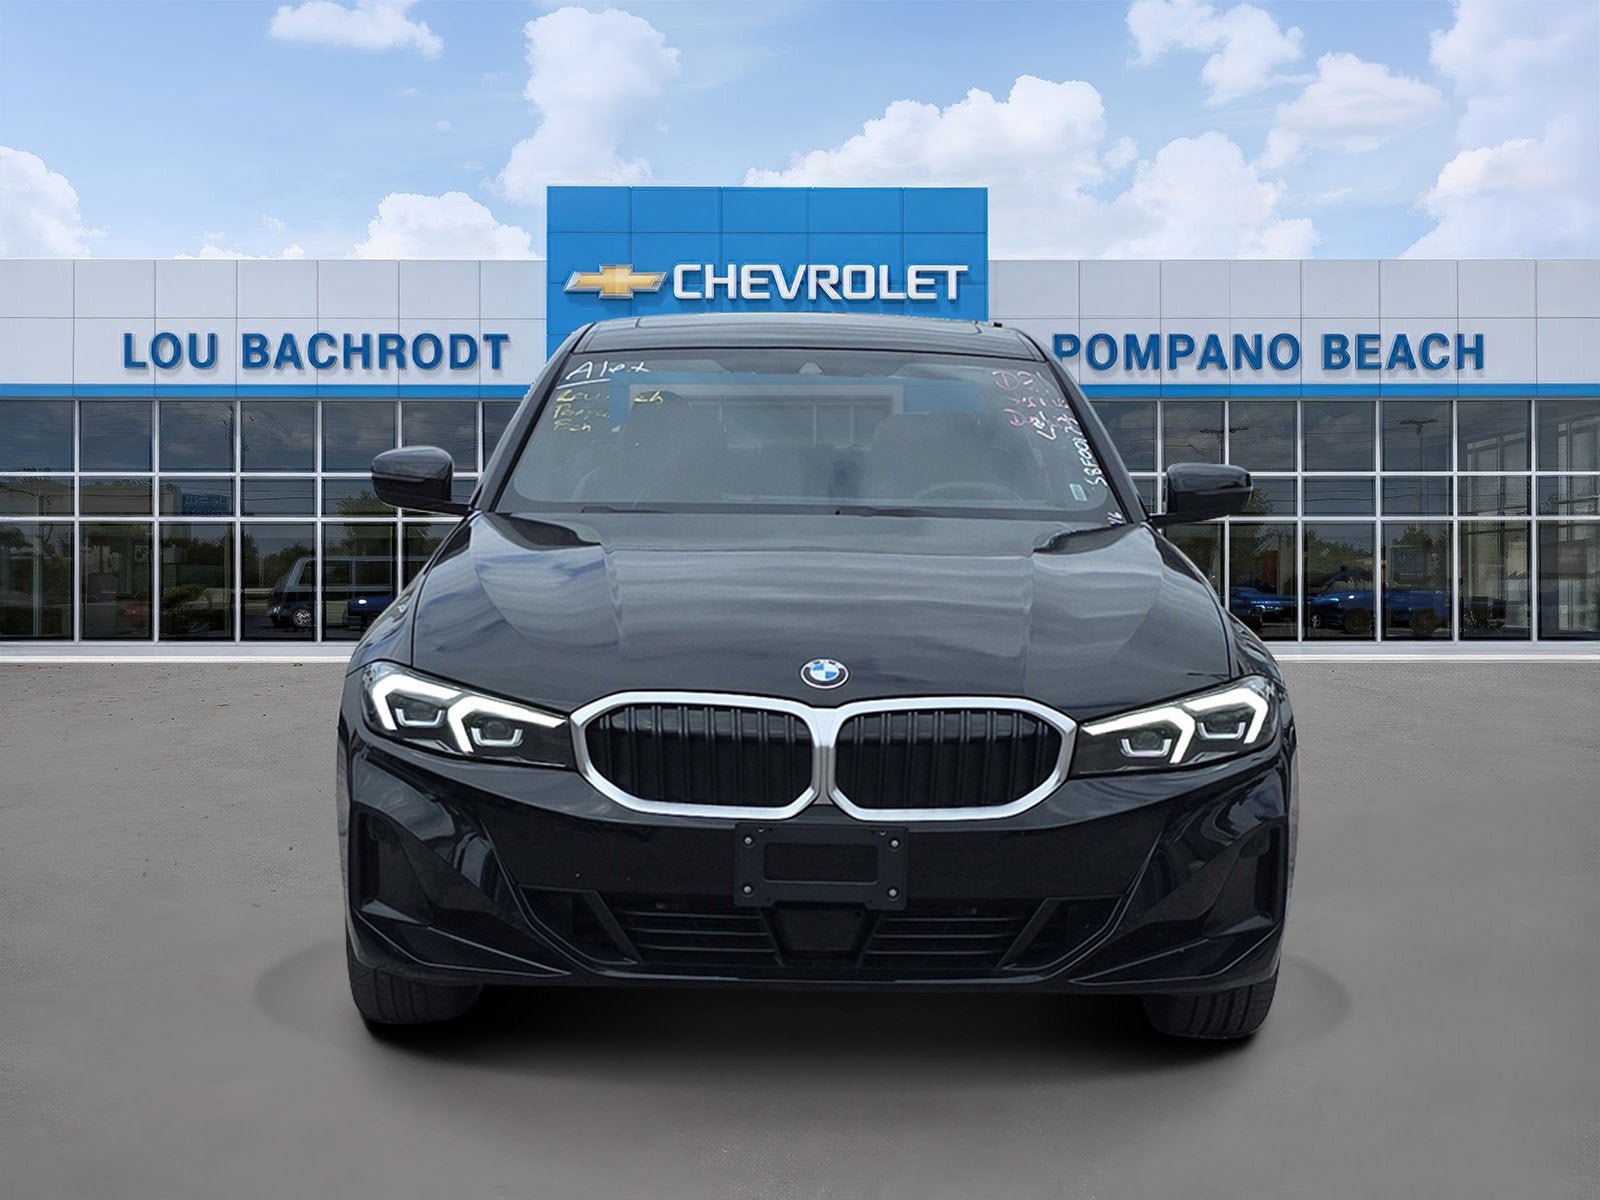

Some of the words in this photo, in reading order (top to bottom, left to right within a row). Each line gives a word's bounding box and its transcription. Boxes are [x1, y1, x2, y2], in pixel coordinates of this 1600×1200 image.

[673, 264, 968, 300] CHEVROLET
[123, 332, 217, 369] LOU
[242, 332, 510, 370] BACHRODT
[1053, 332, 1301, 371] POMPANO
[1321, 332, 1484, 370] BEACH
